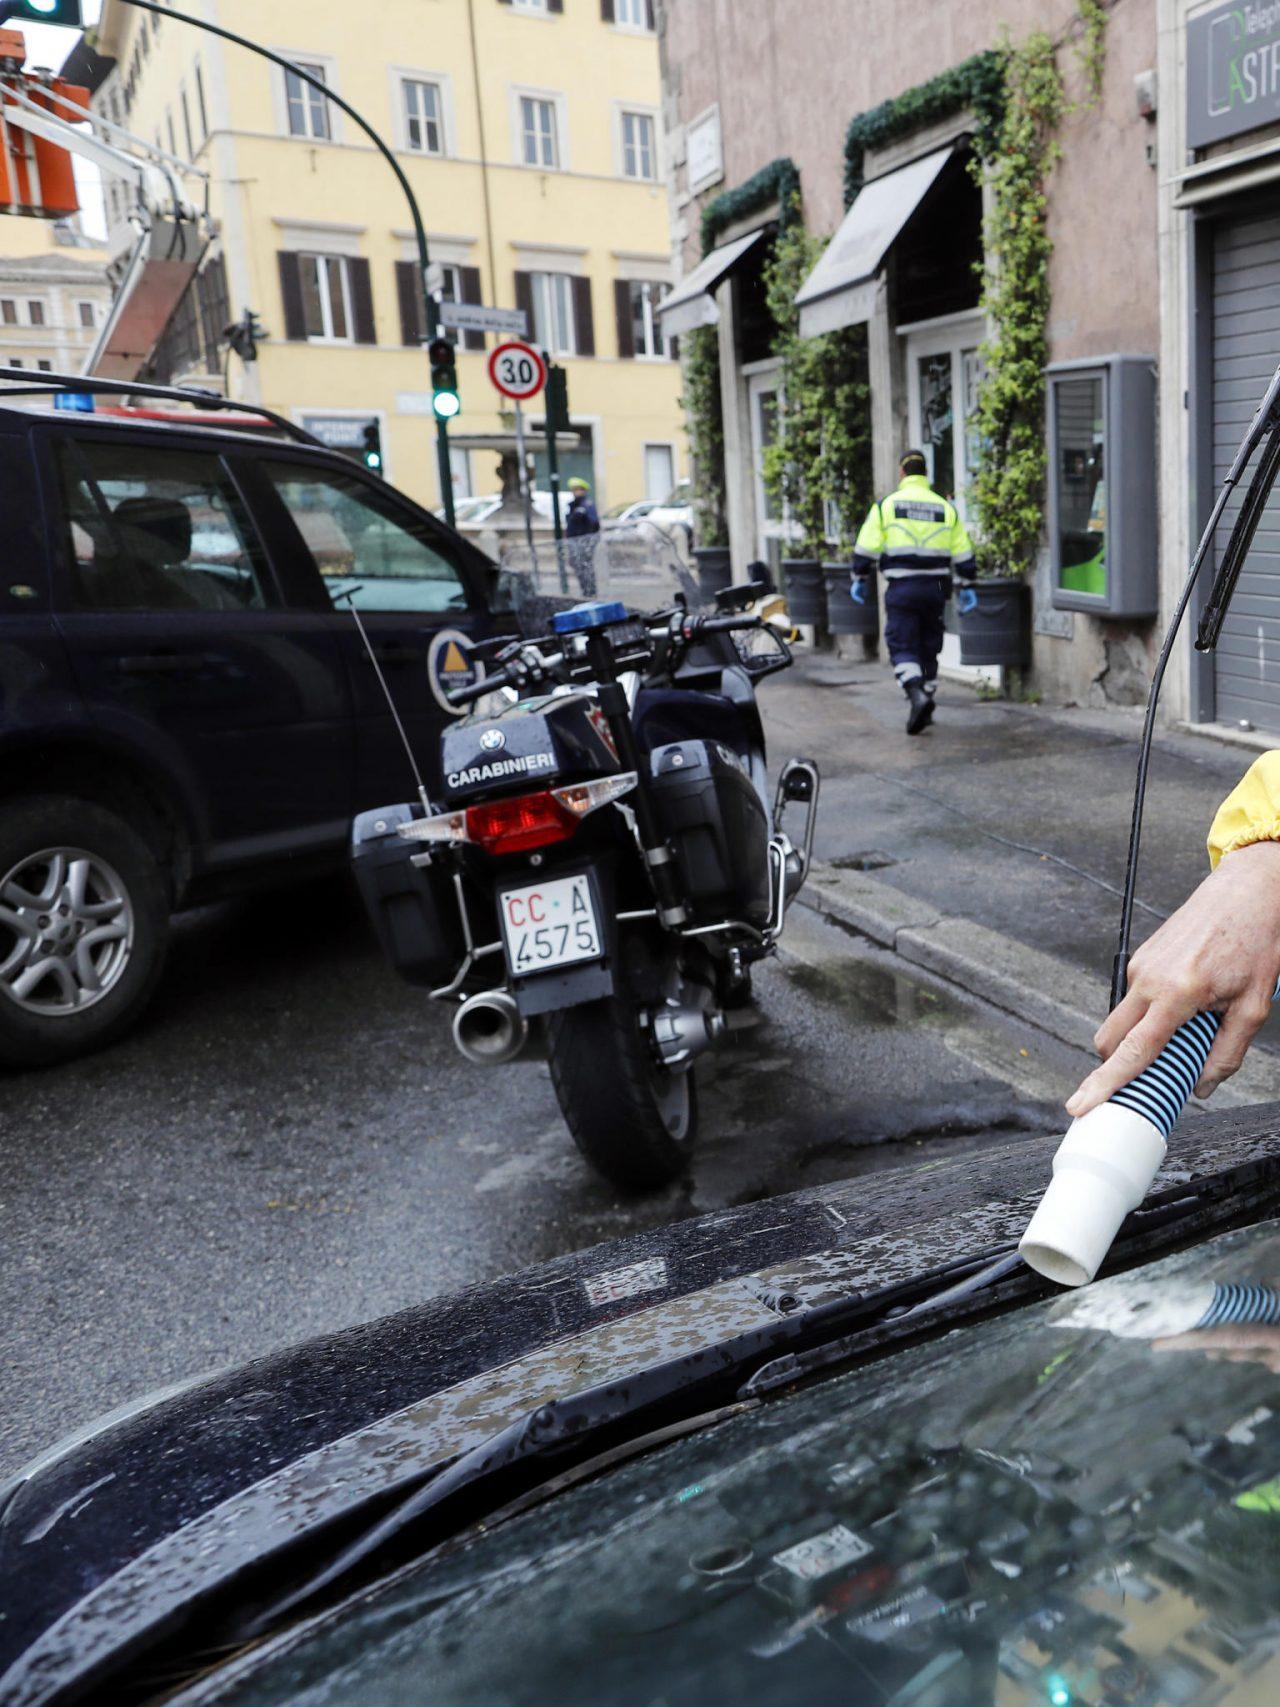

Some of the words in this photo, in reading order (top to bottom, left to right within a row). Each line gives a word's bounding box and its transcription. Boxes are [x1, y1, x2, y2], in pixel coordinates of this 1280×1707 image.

[501, 357, 532, 384] 30
[447, 752, 555, 789] CARABINIERI
[508, 893, 546, 927] CC
[572, 884, 588, 915] A
[516, 919, 593, 963] 4575
